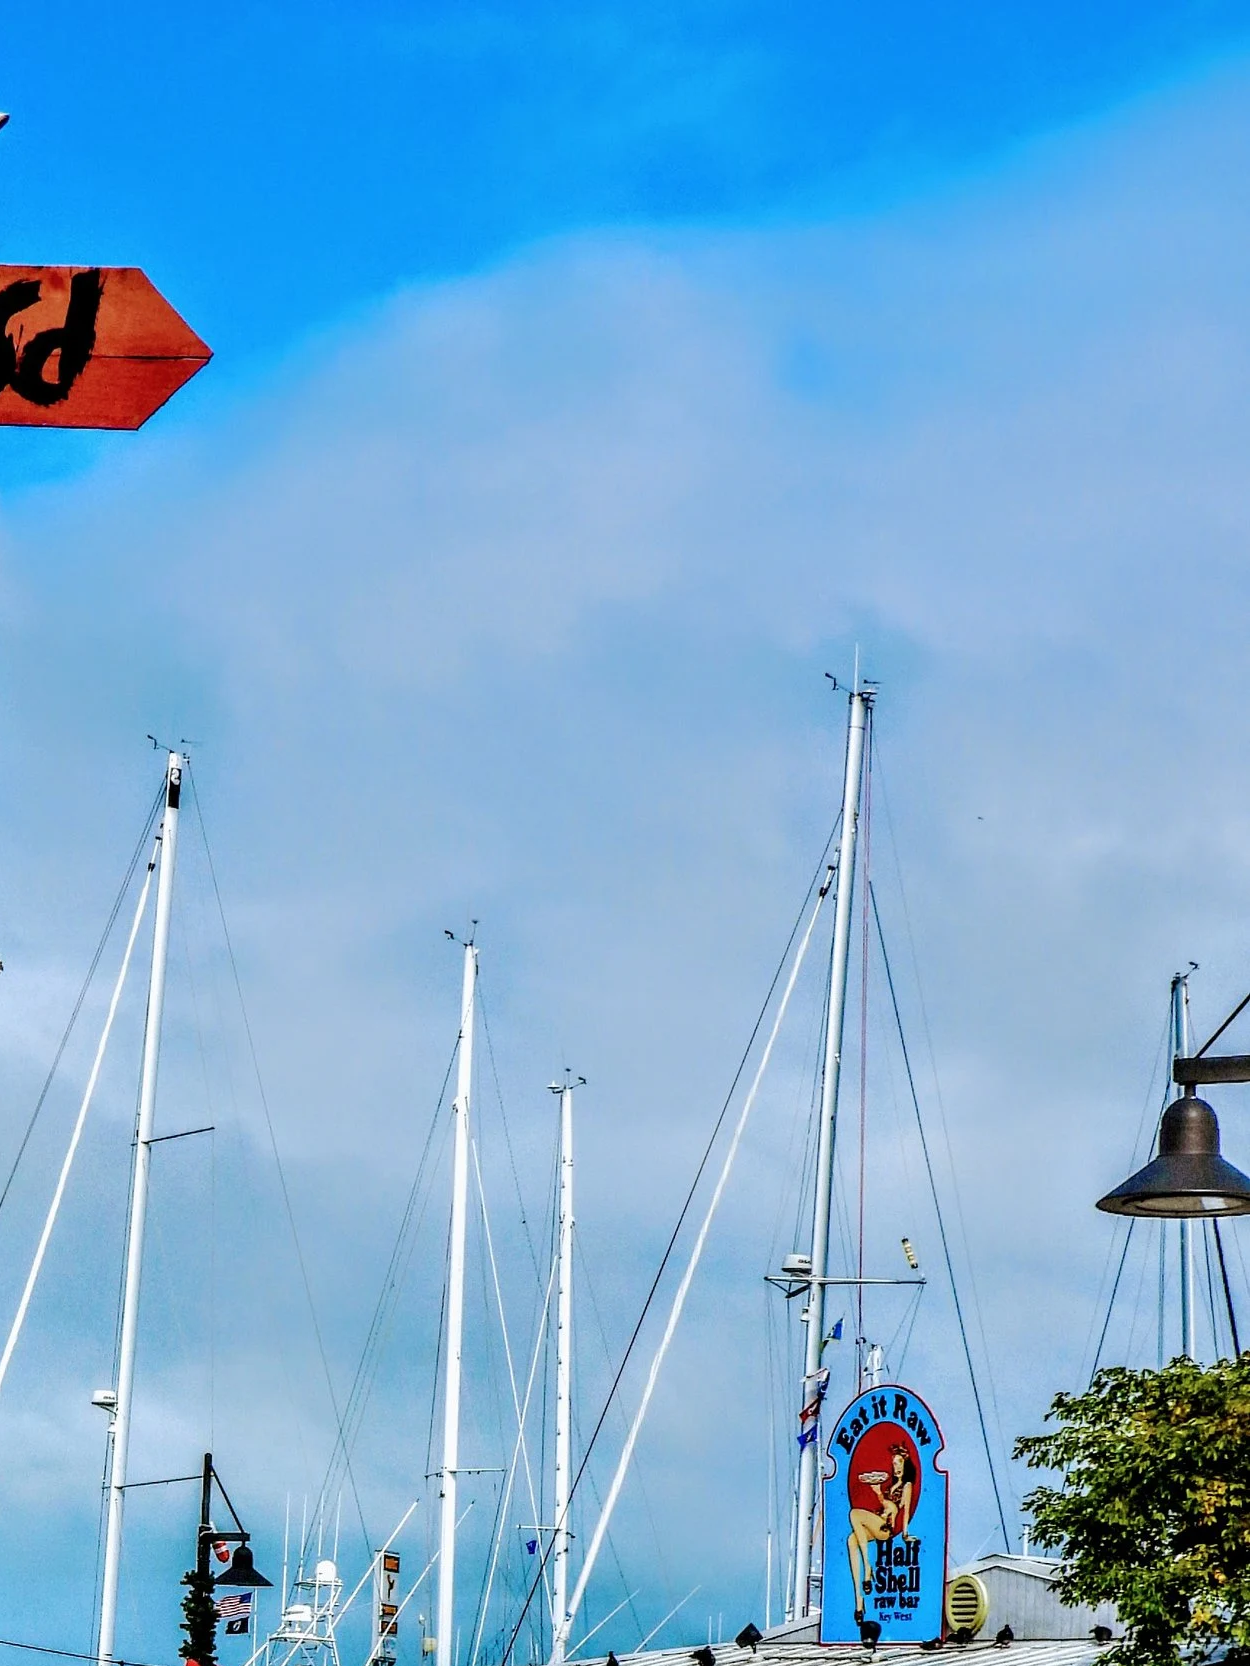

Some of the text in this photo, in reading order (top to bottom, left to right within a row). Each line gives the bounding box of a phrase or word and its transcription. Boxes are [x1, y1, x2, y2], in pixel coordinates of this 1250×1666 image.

[835, 1392, 932, 1455] Eat it Raw
[875, 1539, 921, 1568] Half
[874, 1566, 921, 1595] Shell
[873, 1592, 920, 1610] raw bar
